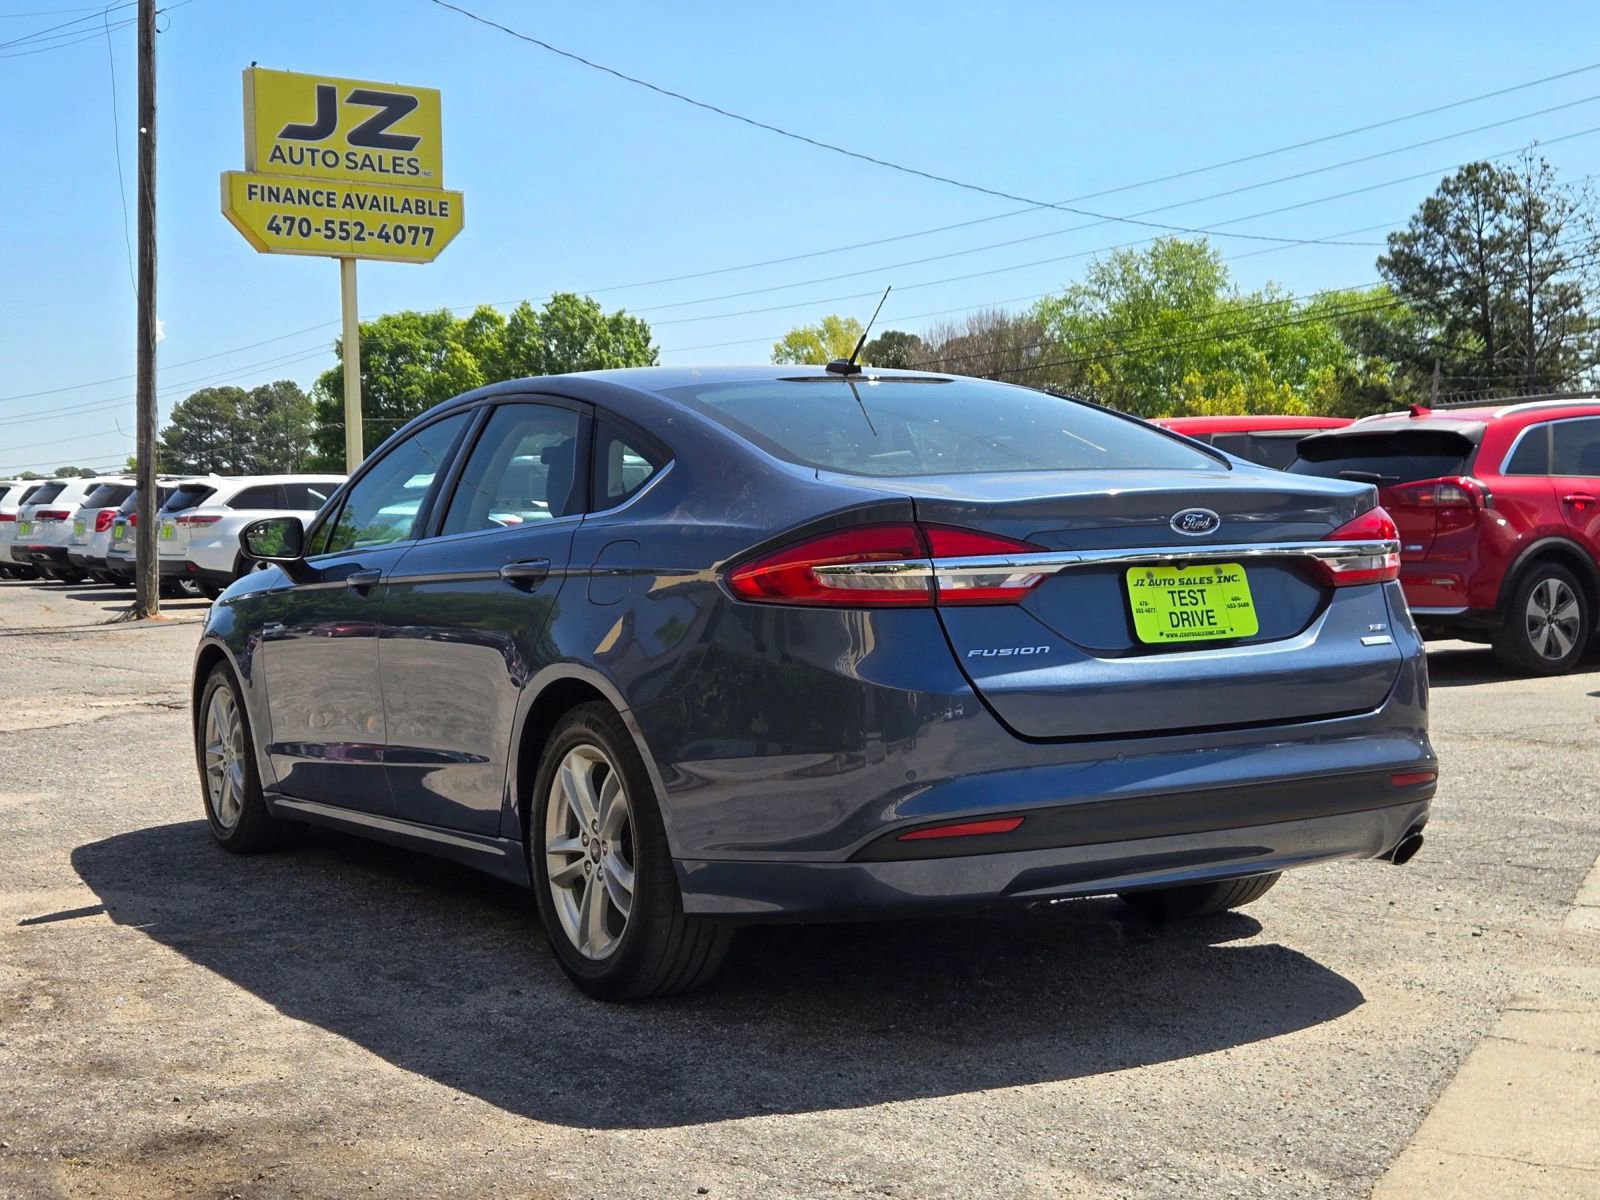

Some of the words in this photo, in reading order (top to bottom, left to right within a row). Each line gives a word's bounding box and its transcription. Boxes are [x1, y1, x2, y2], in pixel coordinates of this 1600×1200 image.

[277, 84, 422, 151] JZ
[269, 144, 340, 168] AUTO
[345, 151, 420, 176] SALES
[247, 184, 337, 209] FINANCE
[342, 192, 449, 217] AVAILABLE
[267, 215, 435, 246] 470-552-4077
[1133, 578, 1146, 587] JZ
[1148, 578, 1175, 587] AUTO
[1178, 576, 1213, 586] SALES
[1216, 574, 1240, 584] INC.
[1168, 588, 1207, 607] TEST
[1169, 609, 1217, 628] DRIVE
[967, 645, 1050, 657] FUSION
